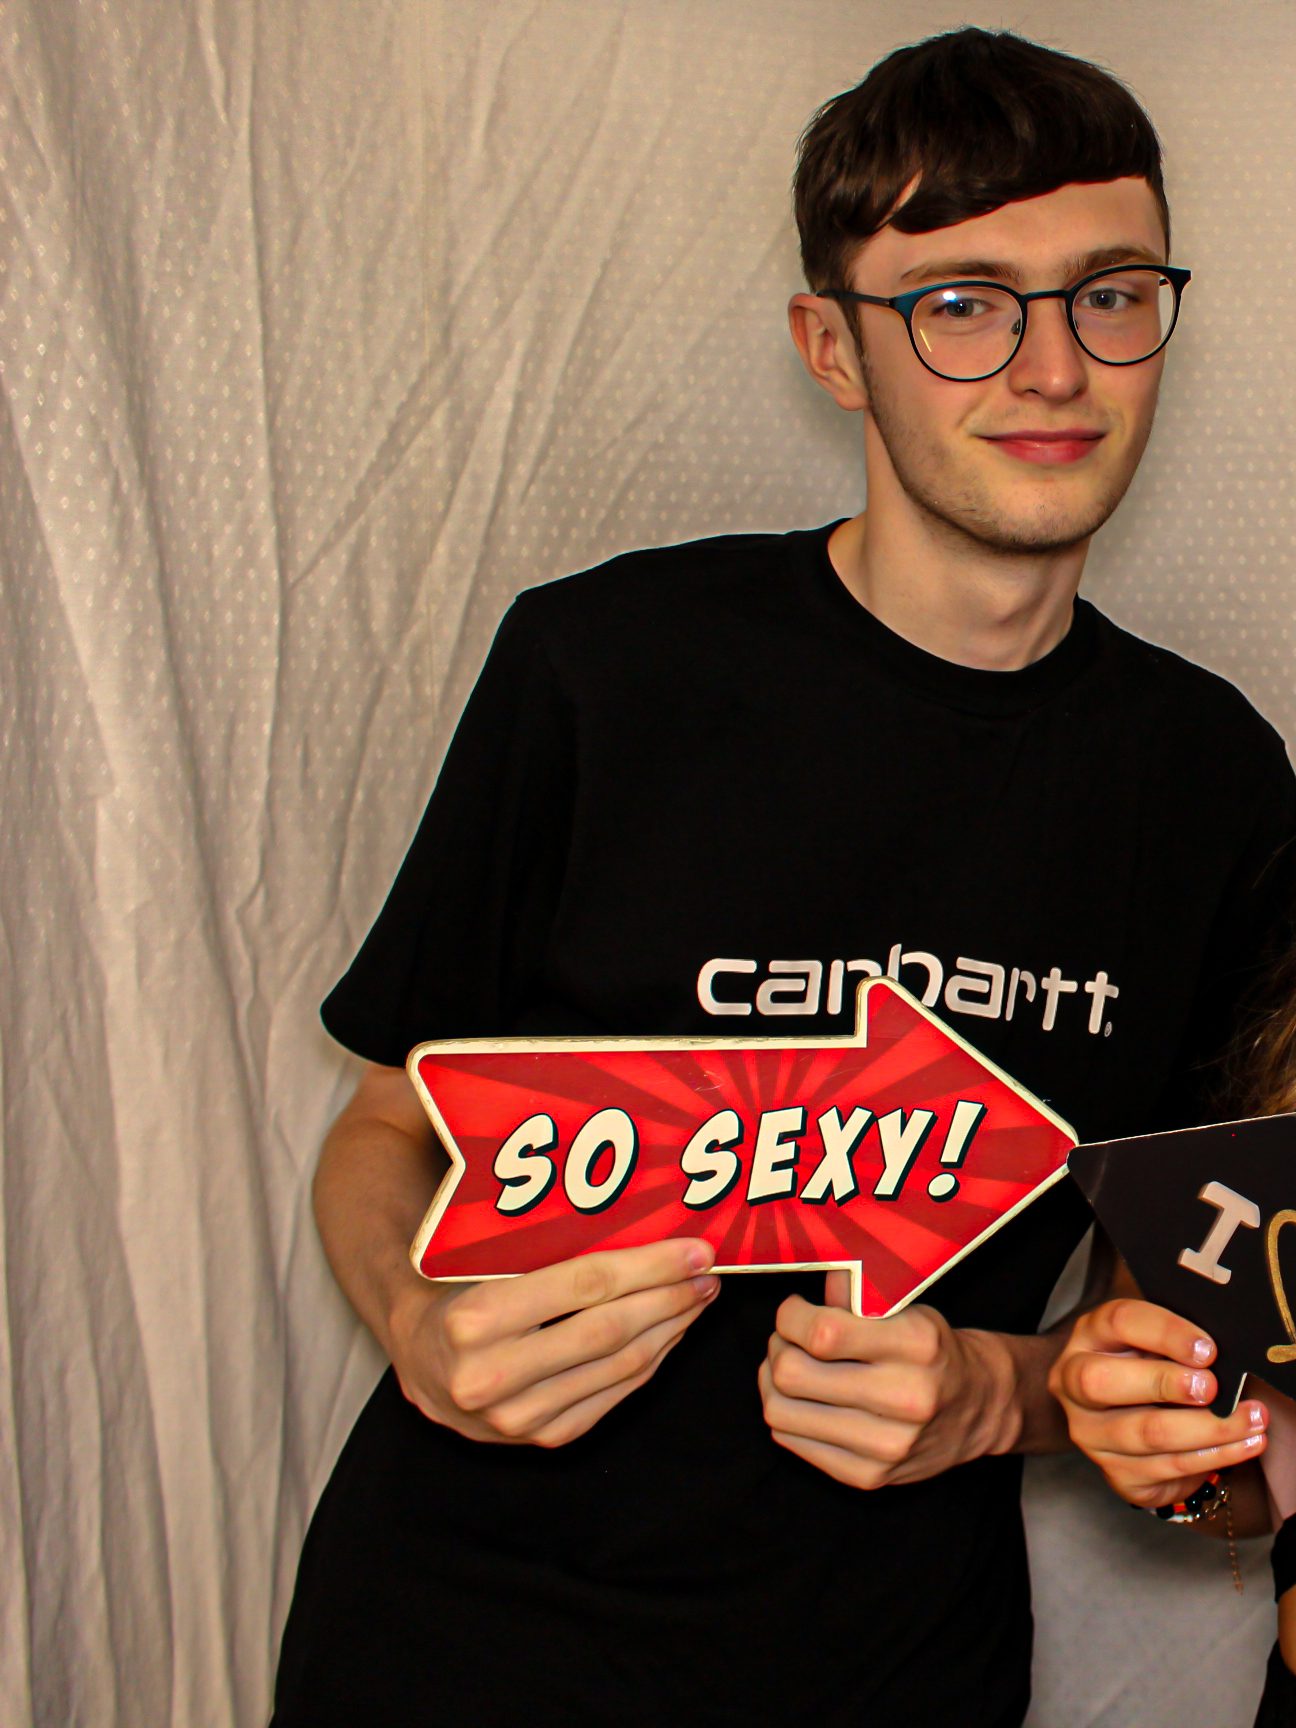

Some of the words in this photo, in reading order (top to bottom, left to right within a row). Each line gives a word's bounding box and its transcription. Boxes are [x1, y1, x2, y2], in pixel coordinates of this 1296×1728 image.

[493, 1107, 639, 1217] SO
[680, 1100, 984, 1210] SEXY!
[1178, 1180, 1260, 1285] I
